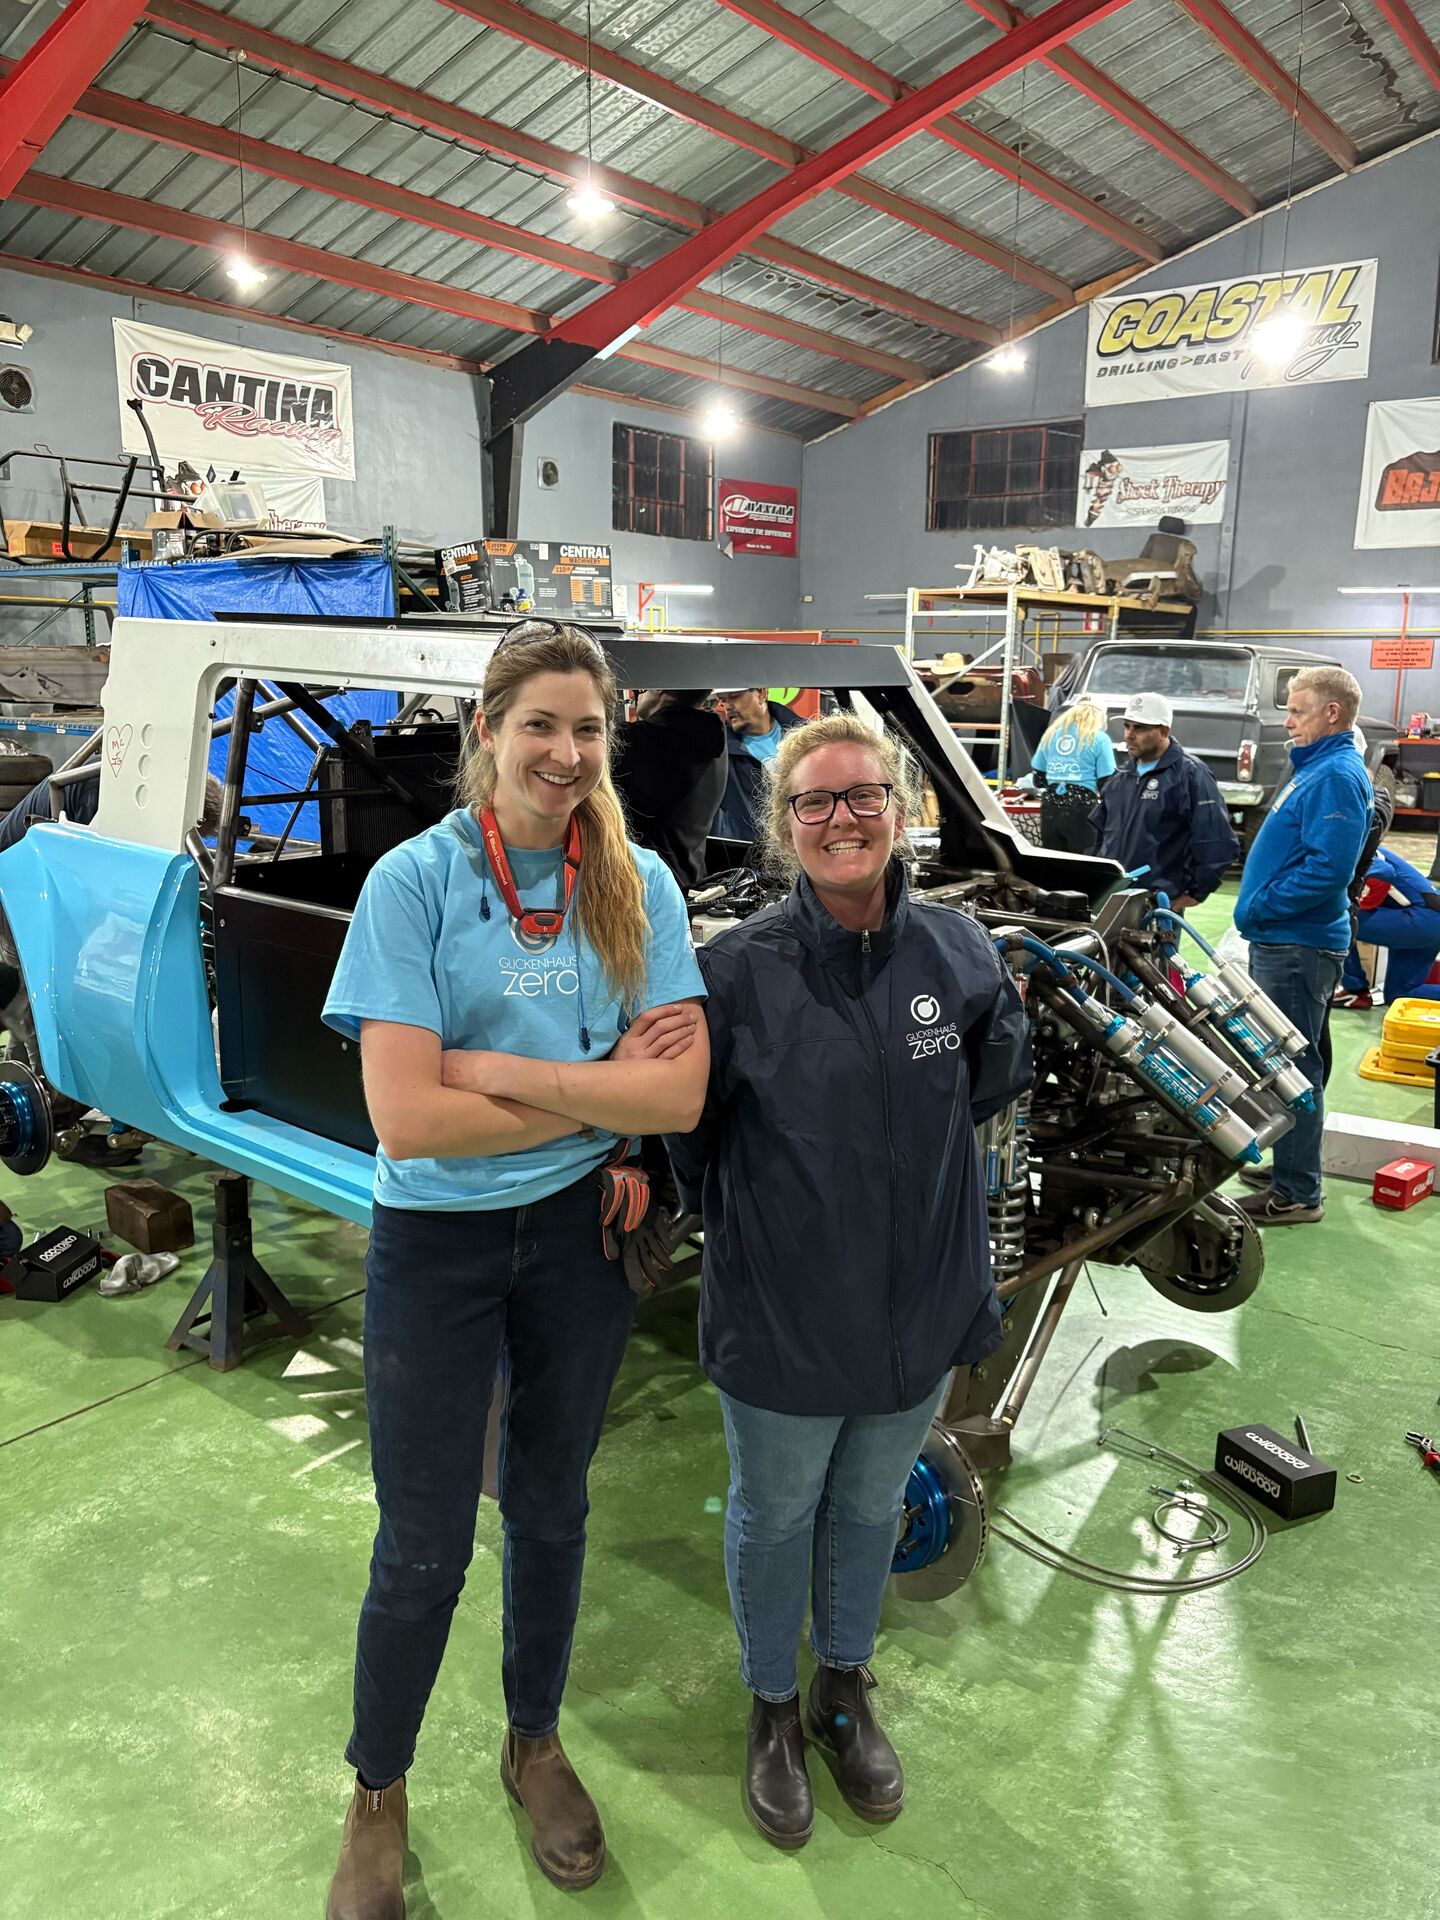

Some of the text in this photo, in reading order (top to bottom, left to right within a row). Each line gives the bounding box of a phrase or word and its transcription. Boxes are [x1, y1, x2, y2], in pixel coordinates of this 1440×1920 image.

[1097, 266, 1362, 357] COASTAL
[1096, 358, 1178, 378] DRILLING
[133, 355, 338, 429] CANTINA
[194, 400, 343, 453] Racing
[1116, 475, 1227, 504] Shock Therapy
[1381, 468, 1440, 505] BAJ
[743, 501, 795, 517] MAXIMA
[441, 543, 478, 560] CENTRAL
[560, 545, 609, 558] CENTRAL
[1046, 761, 1081, 774] zero
[489, 836, 508, 886] Black Diamond
[500, 969, 580, 997] zero
[908, 1032, 961, 1060] zero
[1147, 1060, 1197, 1106] OFF-ROA
[1224, 1454, 1281, 1499] wilwood
